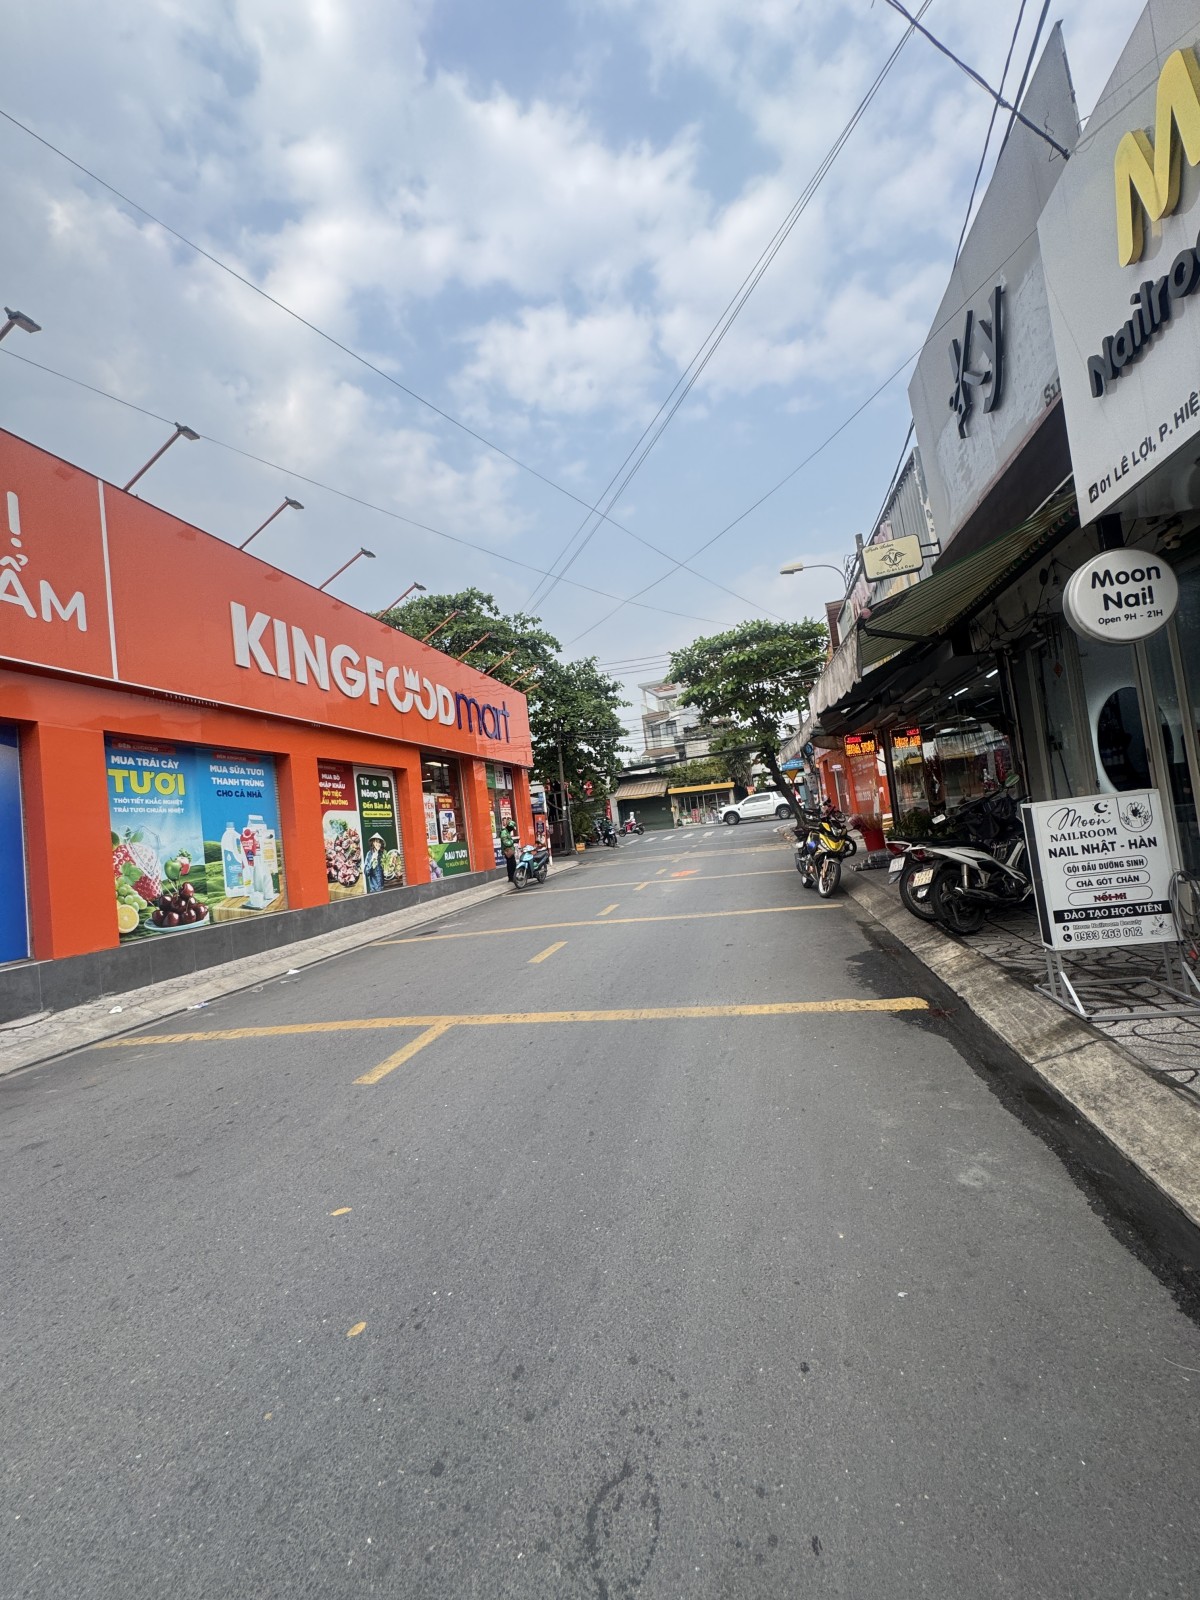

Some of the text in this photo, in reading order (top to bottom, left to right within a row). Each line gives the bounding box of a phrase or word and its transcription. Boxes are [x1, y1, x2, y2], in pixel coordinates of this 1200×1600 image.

[1087, 231, 1200, 398] Nailro
[1100, 390, 1200, 493] 01 LÊ LỢI, P. HIỆ
[1091, 566, 1161, 589] Moon
[1103, 585, 1154, 611] Nail
[1098, 616, 1121, 626] Open
[1124, 613, 1137, 621] 9H
[1147, 609, 1163, 618] 21H
[111, 755, 179, 769] MUA TRÁI CÂY
[210, 765, 264, 776] MUA SỮA TƯƠI
[107, 768, 185, 795] TƯƠI
[211, 777, 265, 787] THANH TRÙNG
[234, 789, 245, 797] CẢ
[247, 790, 262, 798] NHÀ
[1047, 807, 1111, 830] Moon
[1050, 827, 1117, 842] NAILROOM
[1048, 846, 1078, 859] NAIL
[1081, 840, 1116, 855] NHẬT
[1128, 835, 1158, 849] HÀN
[1067, 858, 1144, 874] GỘI ĐẦU DƯỠNG SINH
[1076, 875, 1140, 888] CHÀ GÓT CHÂN
[1064, 903, 1162, 920] ĐÀO TẠO HỌC VIÊN
[1074, 926, 1143, 941] 0933 266 012
